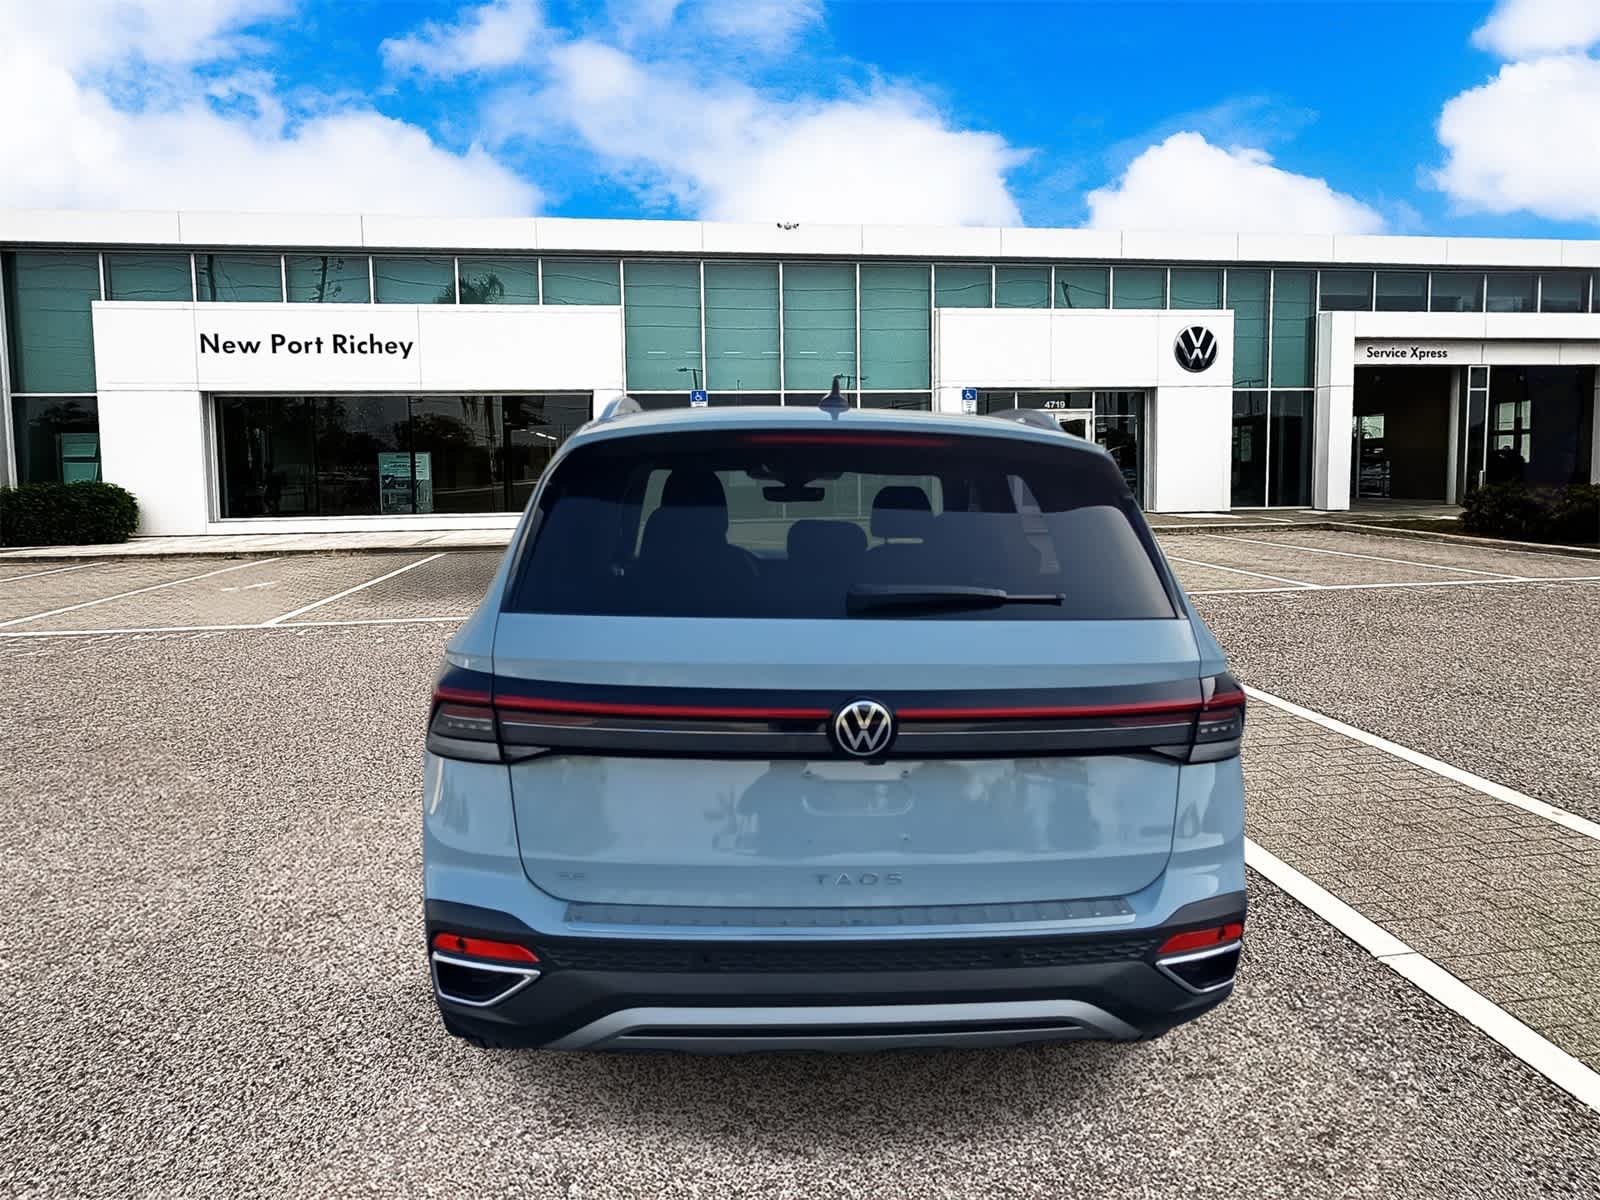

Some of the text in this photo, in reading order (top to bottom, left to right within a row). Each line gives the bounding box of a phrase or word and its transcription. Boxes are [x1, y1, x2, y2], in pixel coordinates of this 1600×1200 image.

[199, 333, 414, 360] New Port Richey
[1366, 346, 1448, 360] Service Xpress
[1043, 400, 1066, 409] 4719
[814, 872, 905, 888] TAOS
